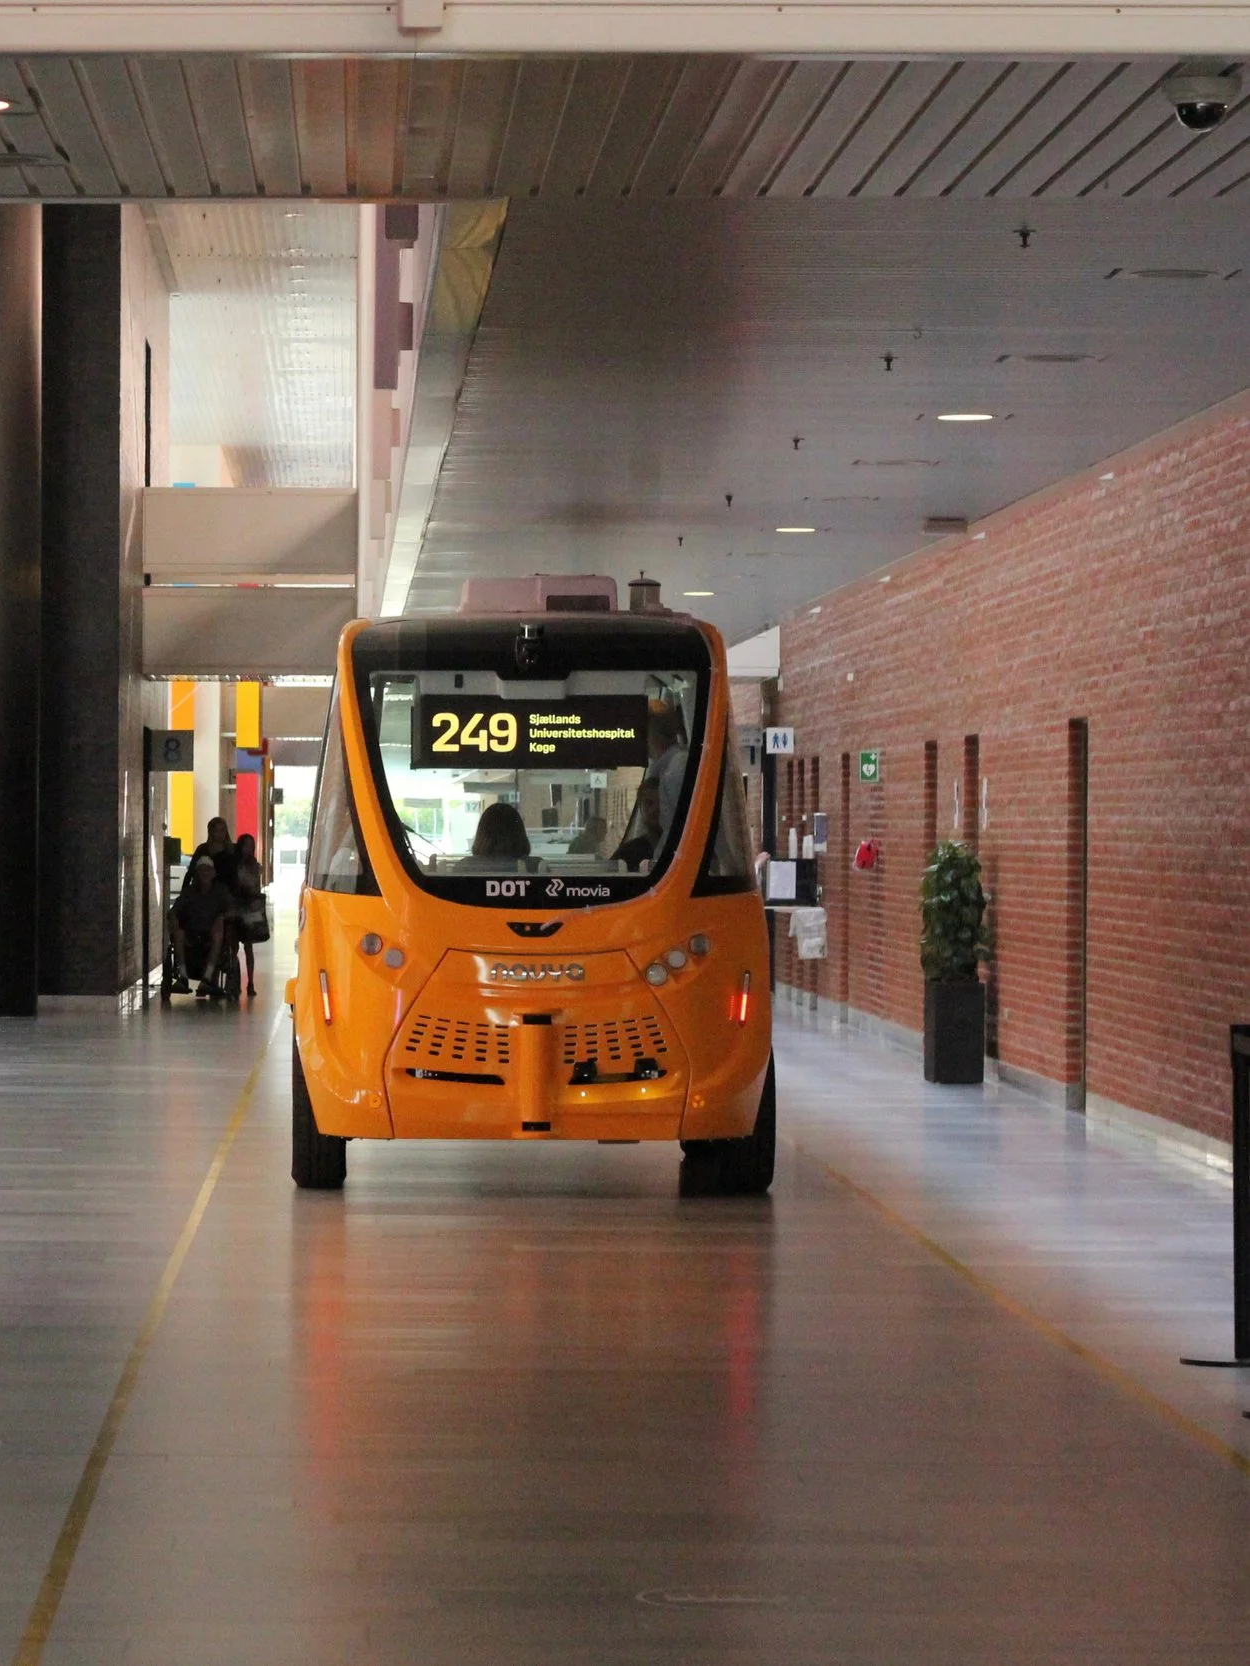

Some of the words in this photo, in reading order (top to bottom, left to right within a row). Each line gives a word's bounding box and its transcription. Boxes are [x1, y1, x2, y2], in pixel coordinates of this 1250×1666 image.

[529, 714, 581, 726] Sjællands
[432, 712, 518, 752] 249
[529, 728, 635, 740] Universitetshospital
[164, 737, 182, 764] 8
[486, 880, 529, 896] DOT
[566, 884, 610, 896] movia
